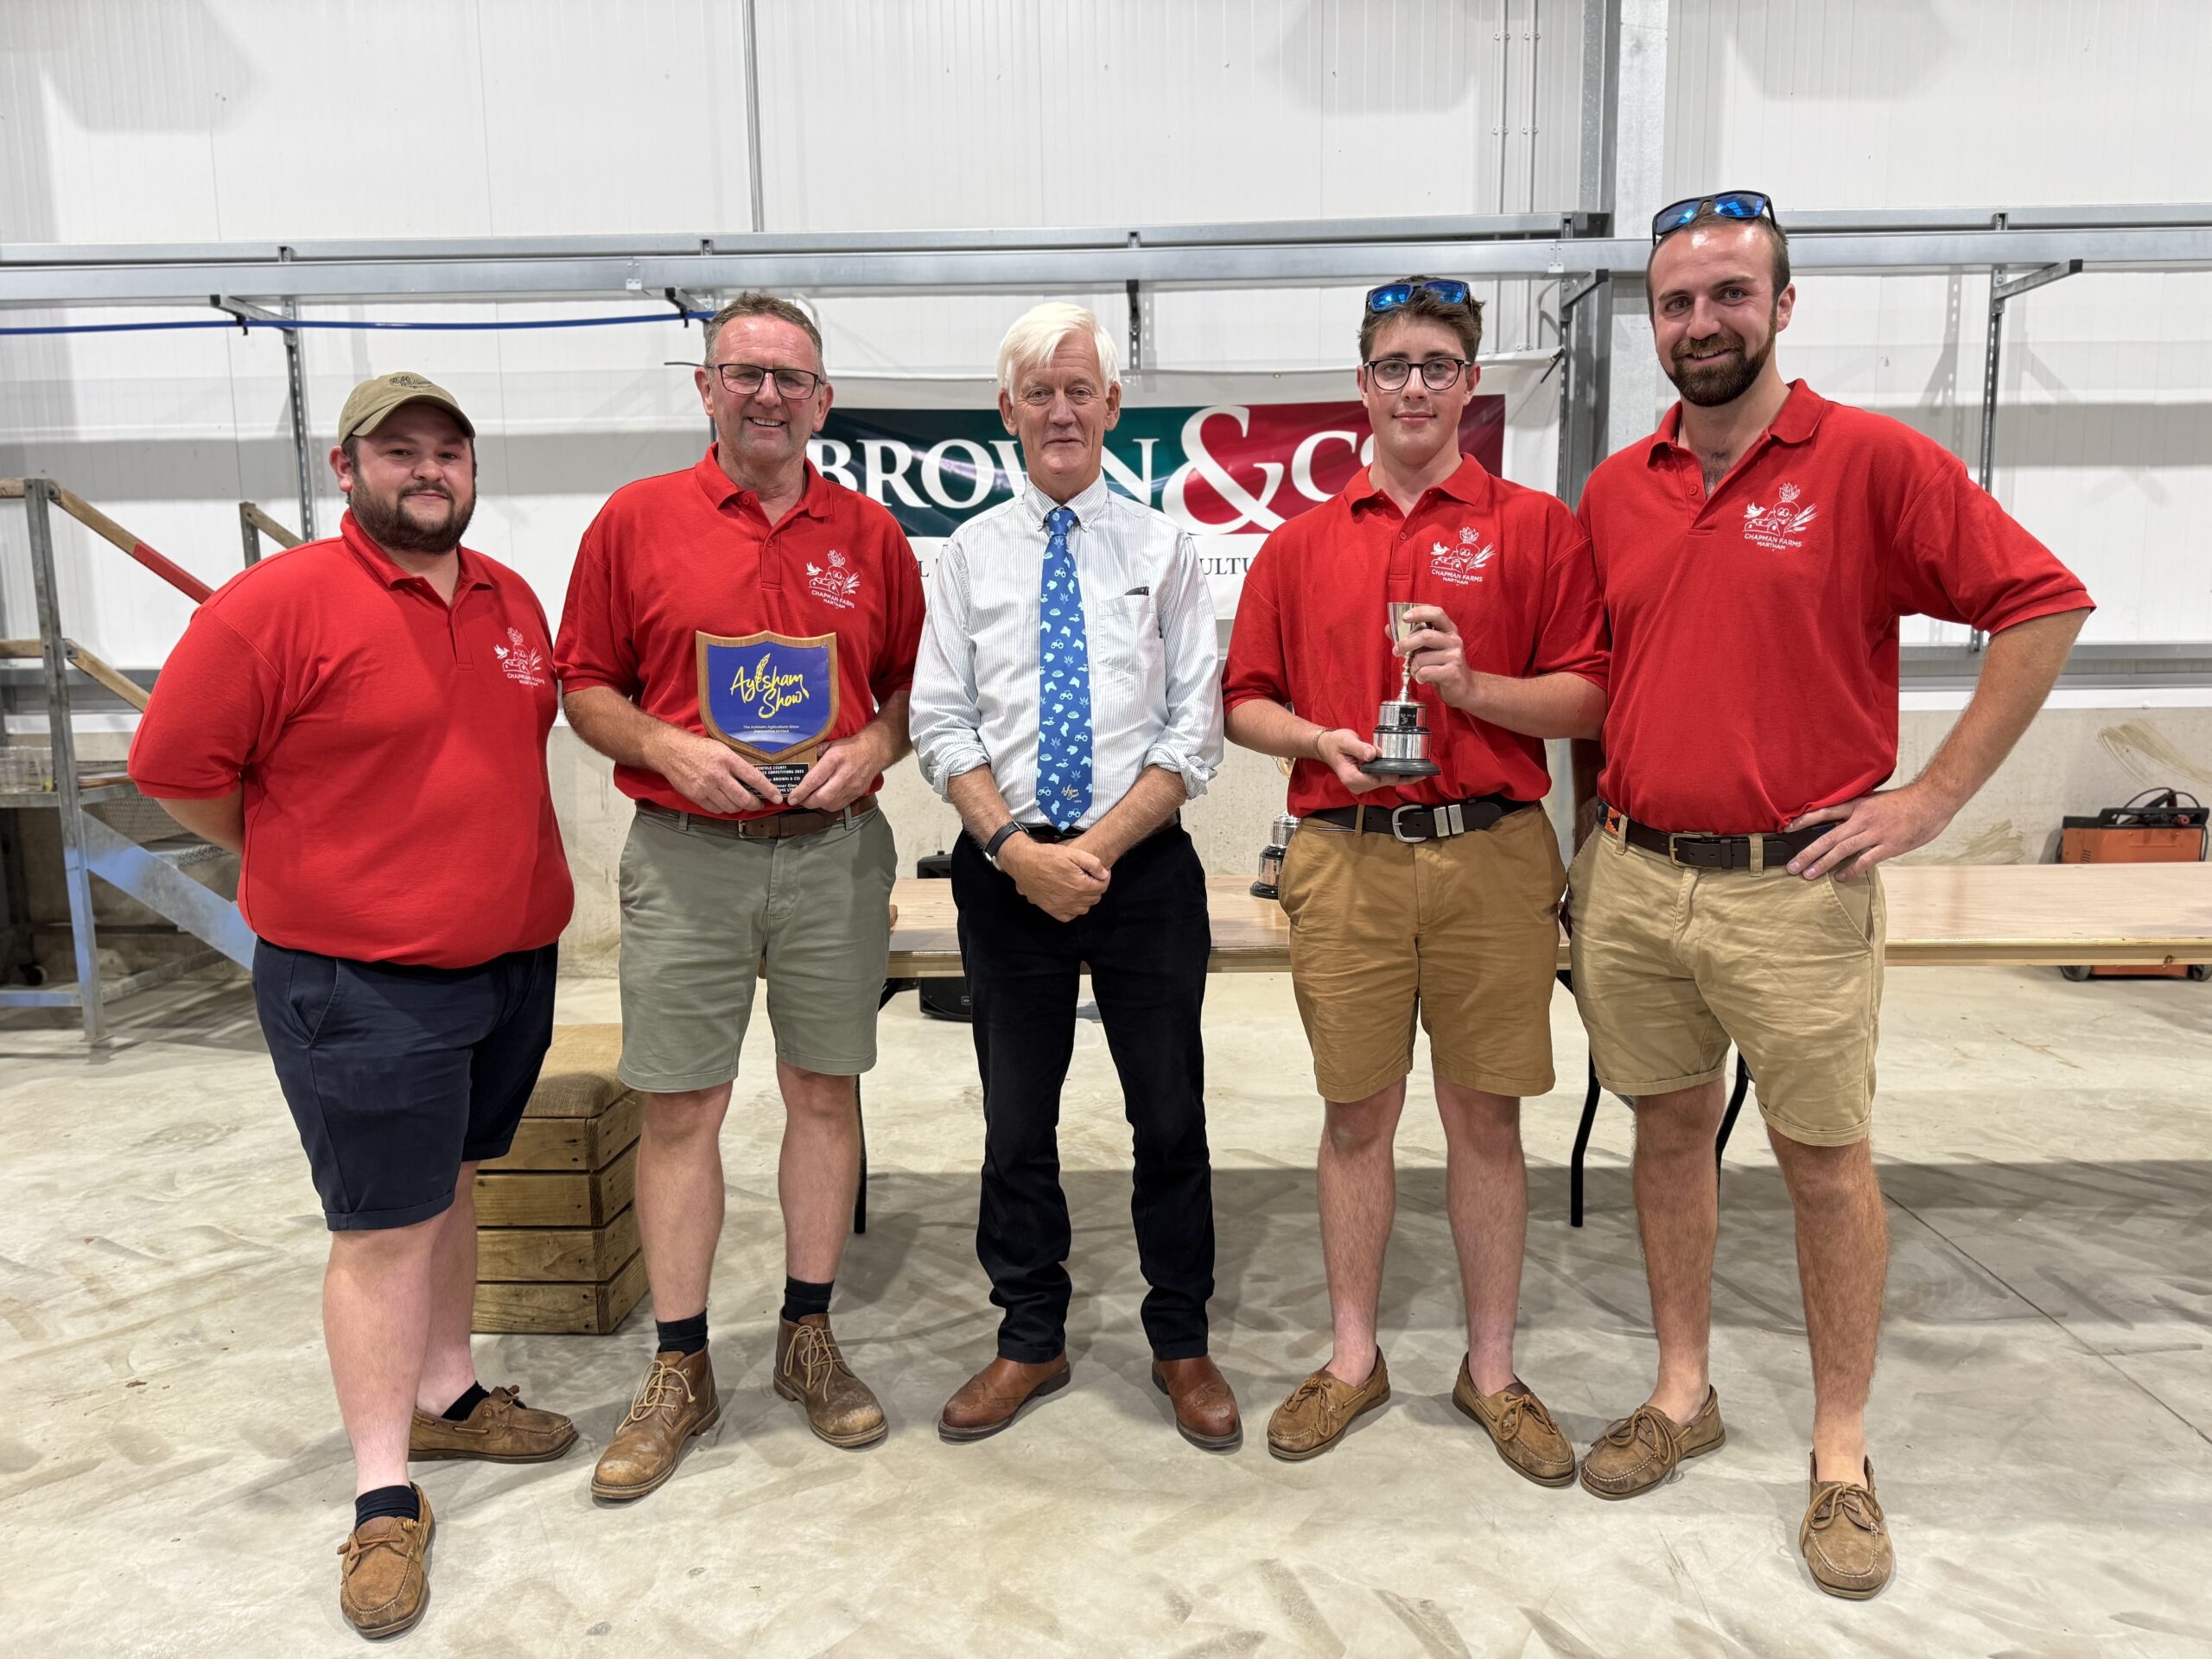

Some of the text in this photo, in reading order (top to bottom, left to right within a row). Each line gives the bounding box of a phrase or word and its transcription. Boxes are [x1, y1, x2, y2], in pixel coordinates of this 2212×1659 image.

[1744, 533, 1802, 548] CHAPMAN FARMS
[1431, 569, 1484, 582] CHAPMAN FARMS
[811, 589, 839, 602] CHAPMAN
[730, 652, 810, 703] Aylsham
[758, 687, 803, 719] Show
